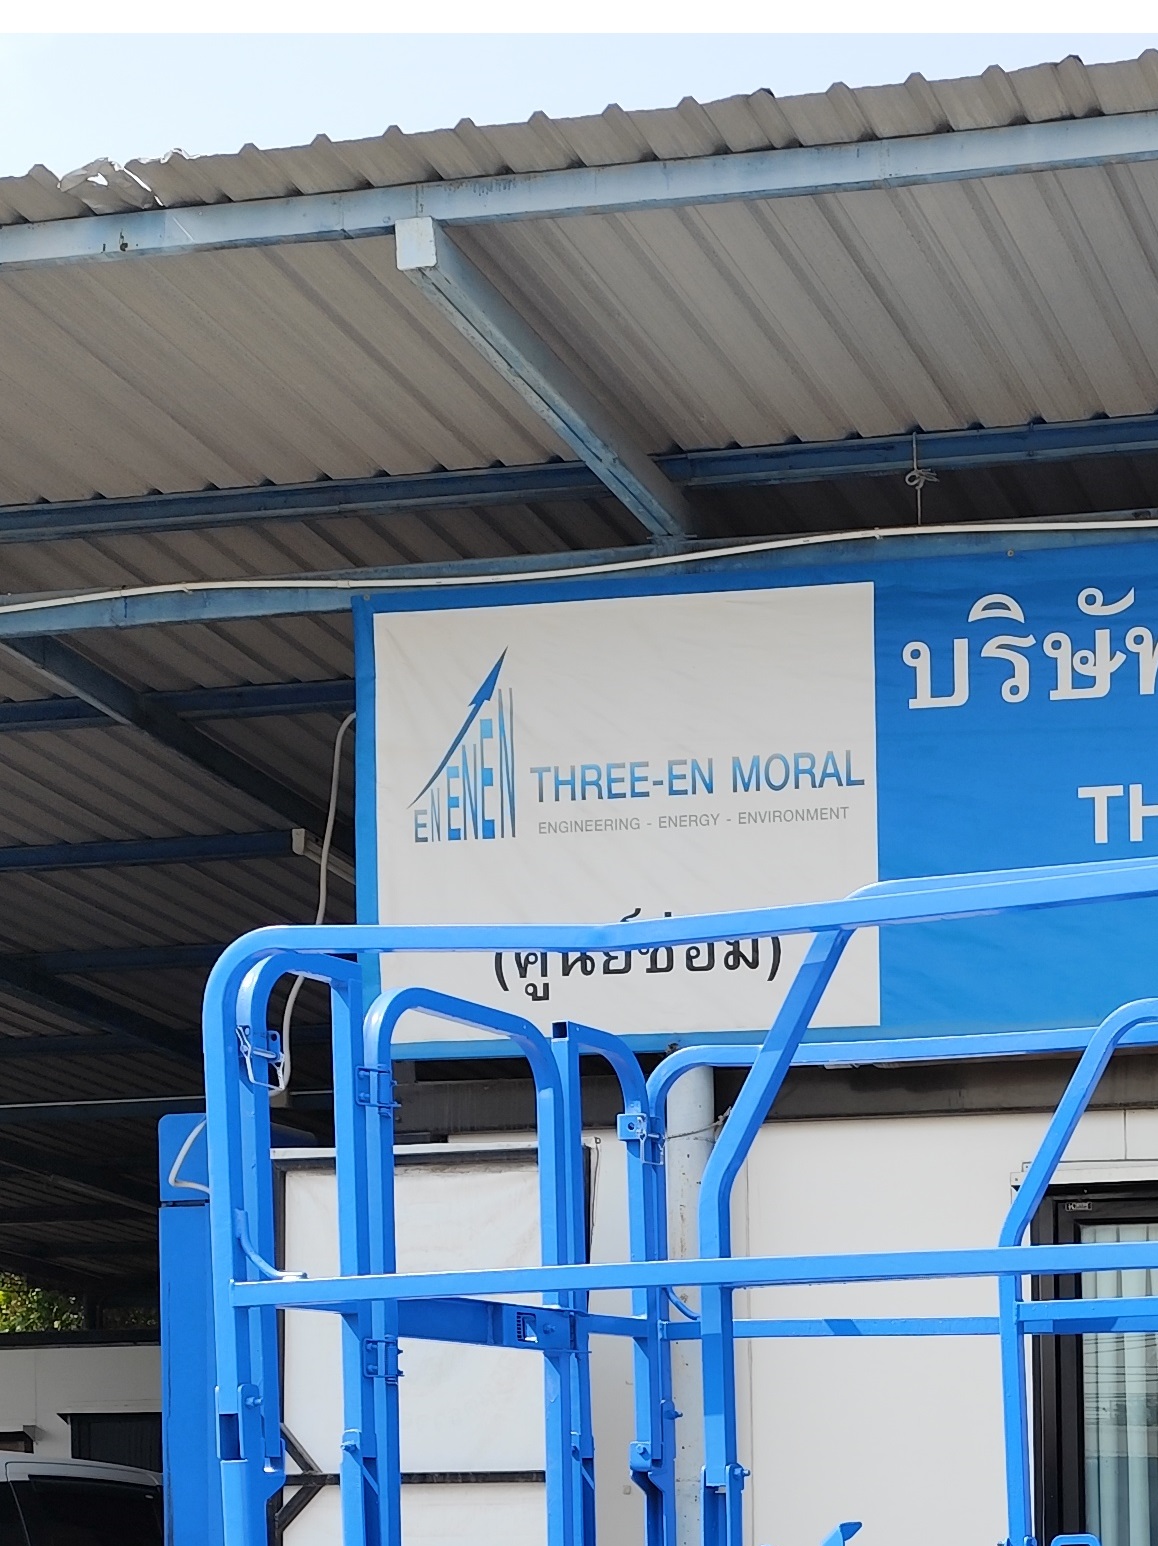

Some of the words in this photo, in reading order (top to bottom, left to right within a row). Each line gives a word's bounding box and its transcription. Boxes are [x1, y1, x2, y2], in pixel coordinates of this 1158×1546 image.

[530, 757, 714, 803] THREE-EN
[732, 749, 865, 793] MORAL
[538, 817, 641, 835] ENGINEERING
[658, 812, 720, 829] ENERGY
[738, 806, 850, 825] ENVIRONMENT
